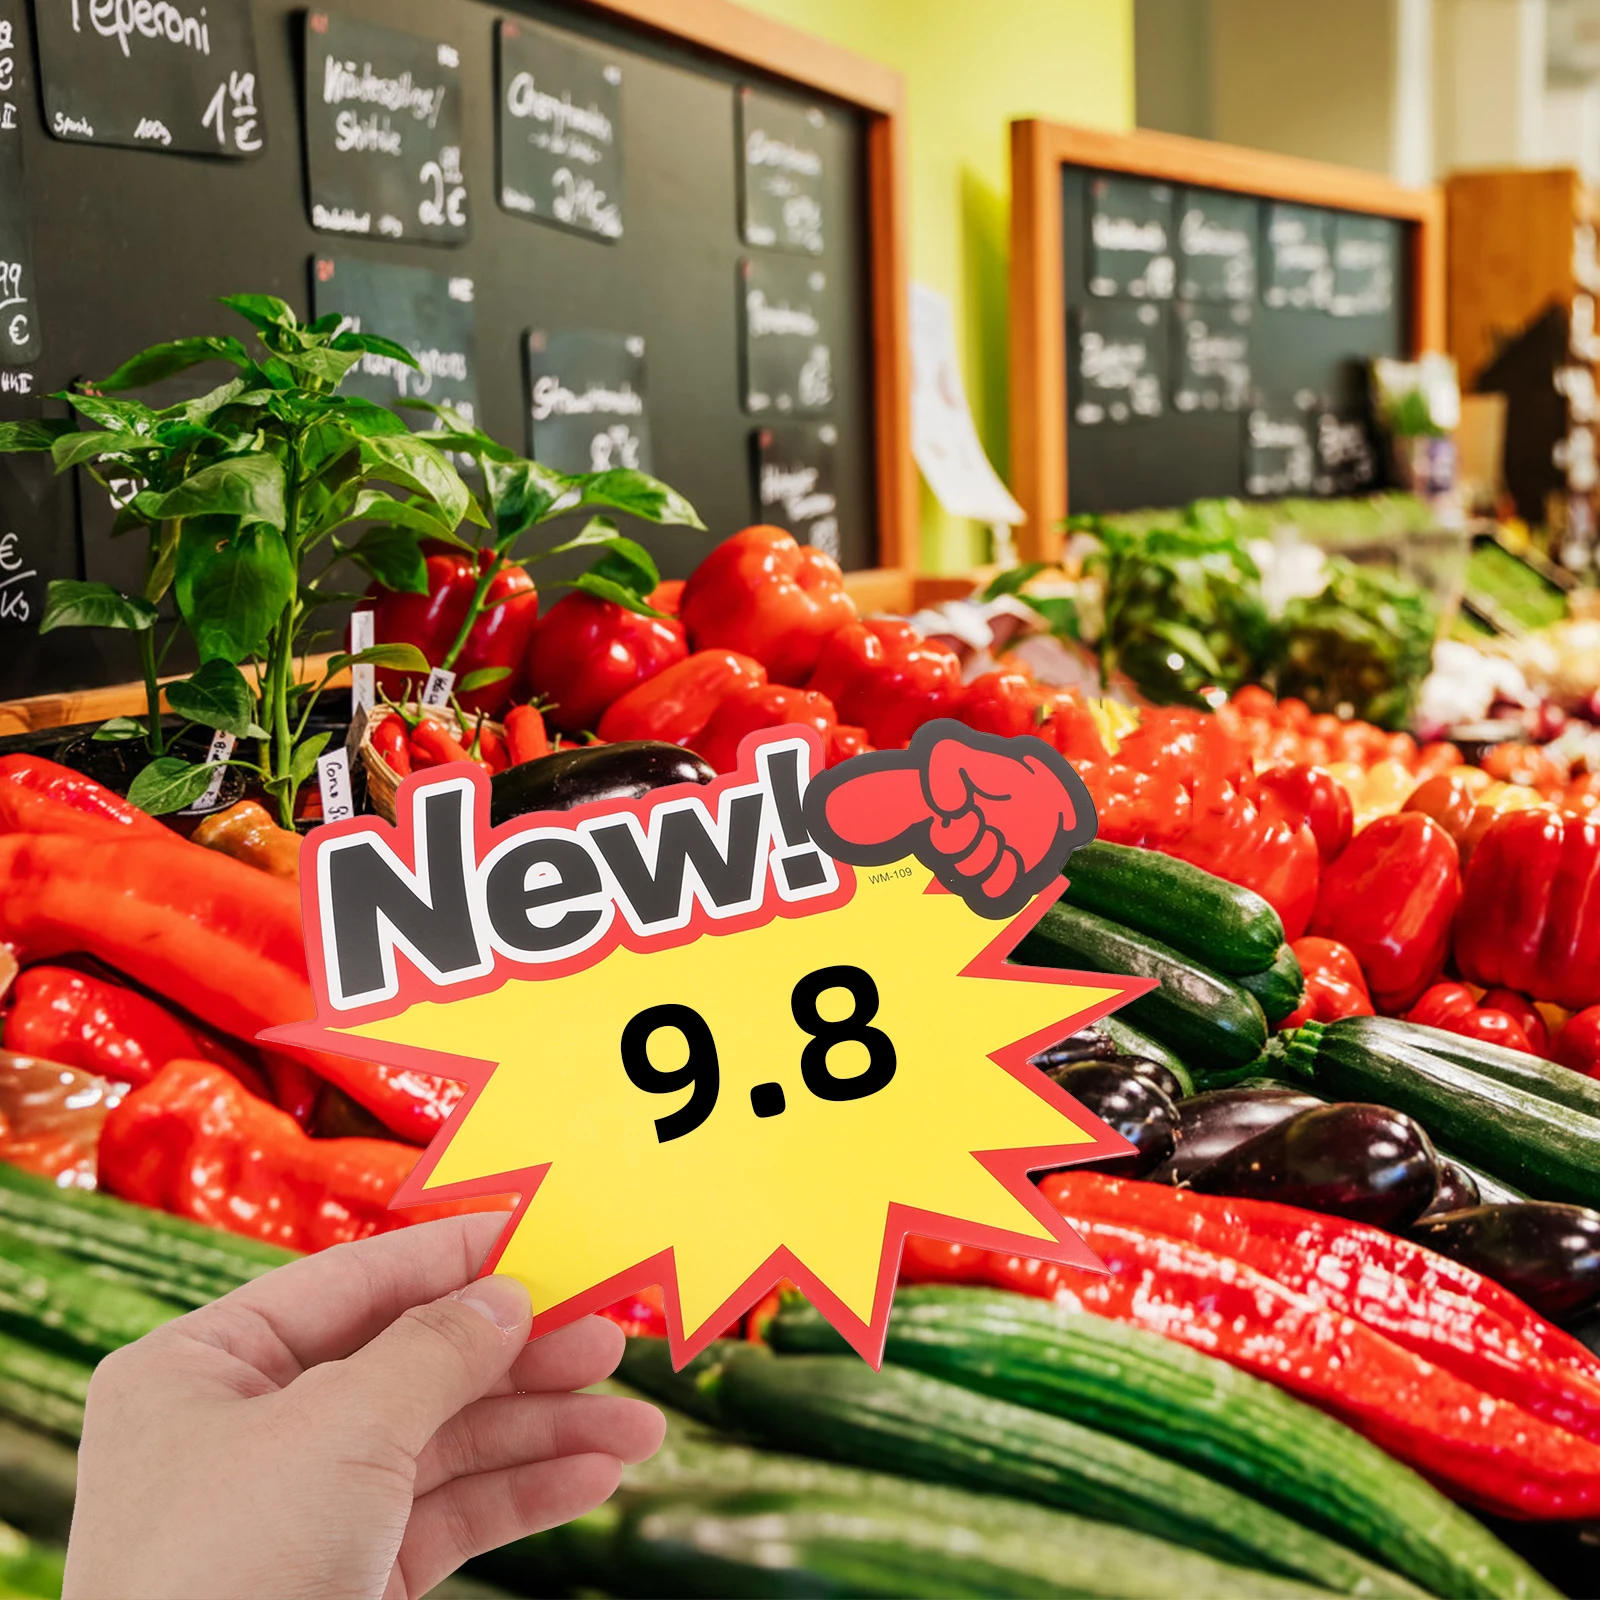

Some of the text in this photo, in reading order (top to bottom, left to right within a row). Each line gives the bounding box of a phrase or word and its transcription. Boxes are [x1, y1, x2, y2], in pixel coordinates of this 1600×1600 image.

[328, 747, 828, 998] New!
[868, 867, 913, 885] WM-109
[621, 966, 896, 1143] 9.8
